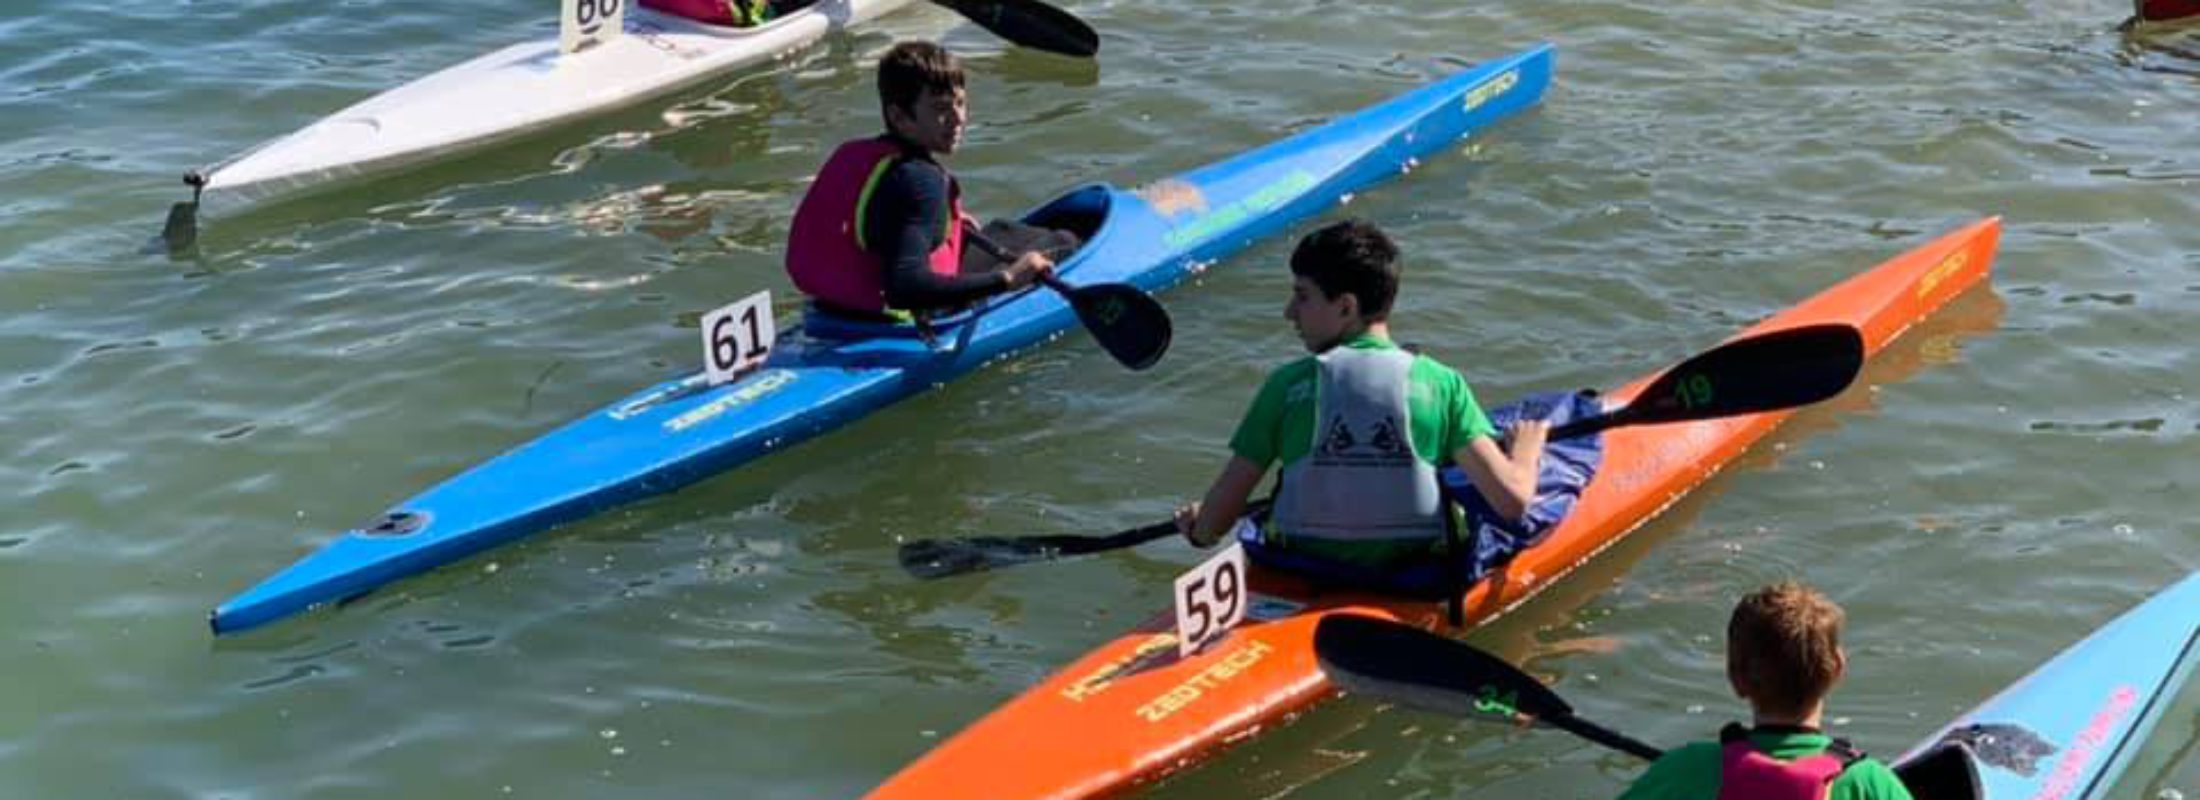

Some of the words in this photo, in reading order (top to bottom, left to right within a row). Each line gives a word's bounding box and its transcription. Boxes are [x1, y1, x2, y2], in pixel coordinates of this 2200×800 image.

[711, 304, 768, 371] 61
[1675, 374, 1713, 409] 19
[1185, 561, 1239, 643] 59
[1135, 639, 1273, 722] ZEDTECH
